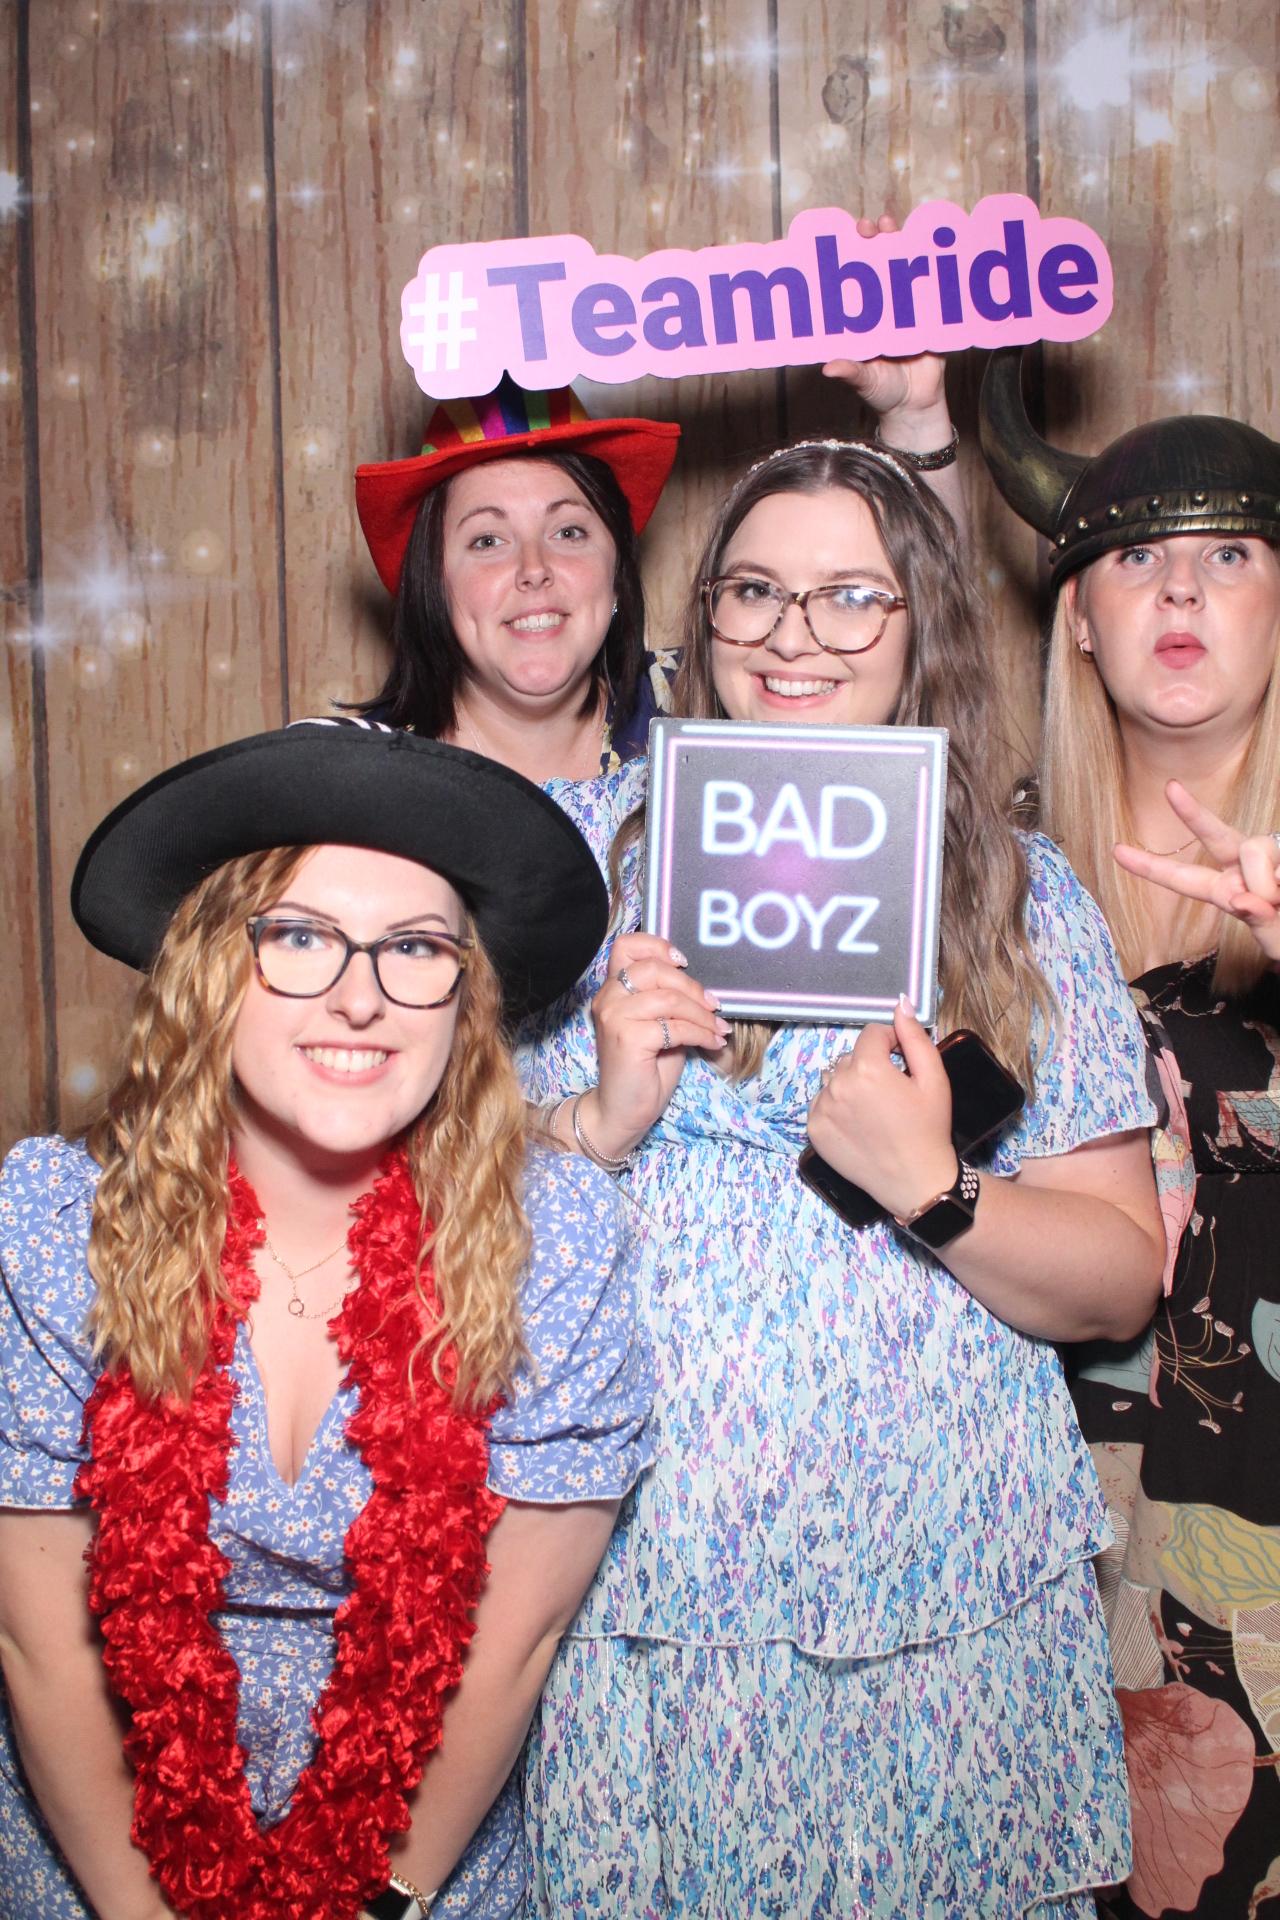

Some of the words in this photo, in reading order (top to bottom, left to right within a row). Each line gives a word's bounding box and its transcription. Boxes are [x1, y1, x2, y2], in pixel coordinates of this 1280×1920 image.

[407, 220, 1099, 372] #Teambride
[701, 780, 887, 860] BAD
[698, 889, 880, 954] BOYZ
